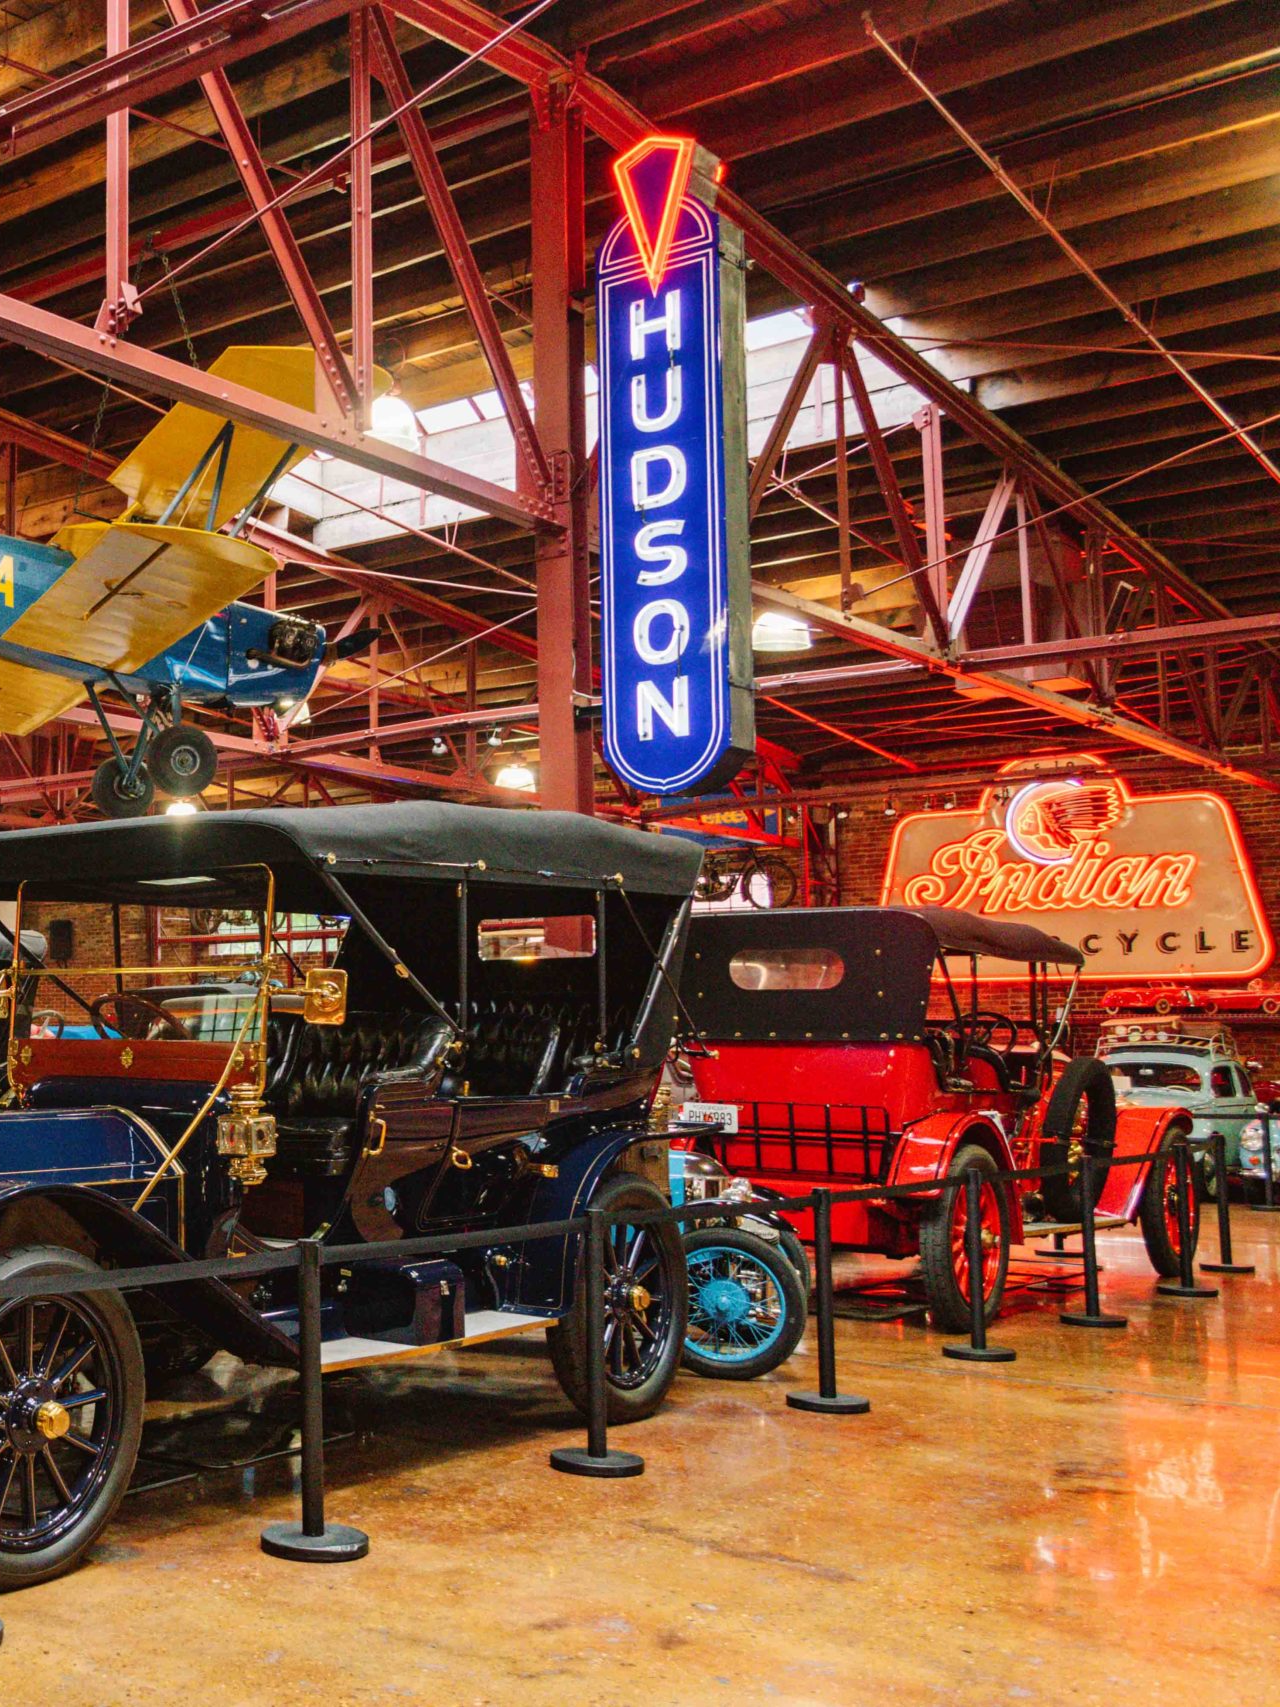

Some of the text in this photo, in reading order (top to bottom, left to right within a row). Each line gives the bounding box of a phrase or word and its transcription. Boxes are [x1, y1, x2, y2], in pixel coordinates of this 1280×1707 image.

[629, 288, 691, 743] HUDSON
[904, 828, 1197, 914] Indian
[1050, 930, 1255, 955] CYCLE
